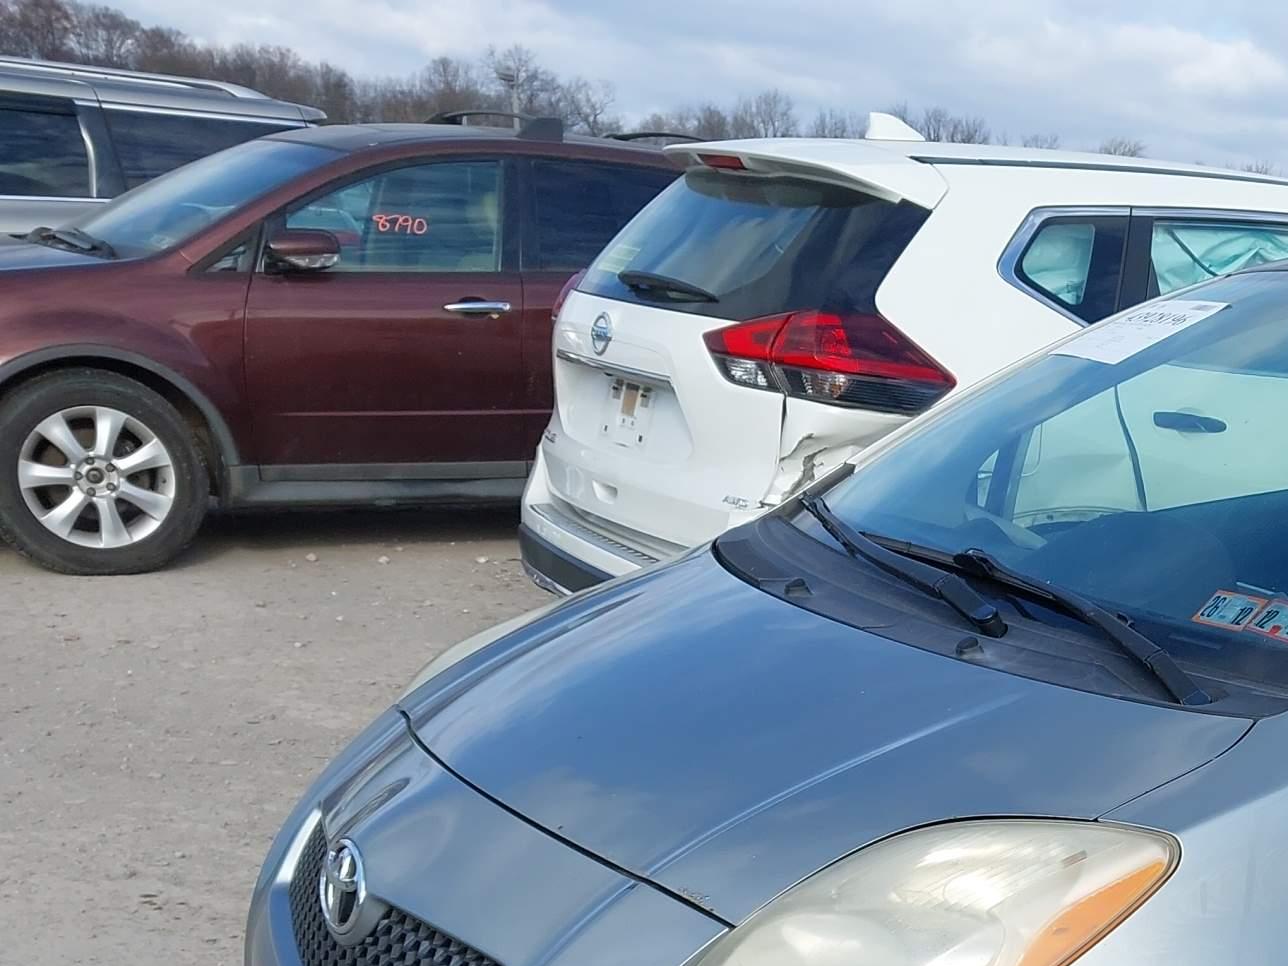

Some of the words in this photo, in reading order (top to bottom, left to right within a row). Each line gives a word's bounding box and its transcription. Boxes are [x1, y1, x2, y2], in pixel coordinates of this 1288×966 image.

[372, 214, 428, 235] 8790
[1200, 595, 1227, 618] 26
[1230, 606, 1254, 626] 12
[1255, 609, 1280, 629] 12
